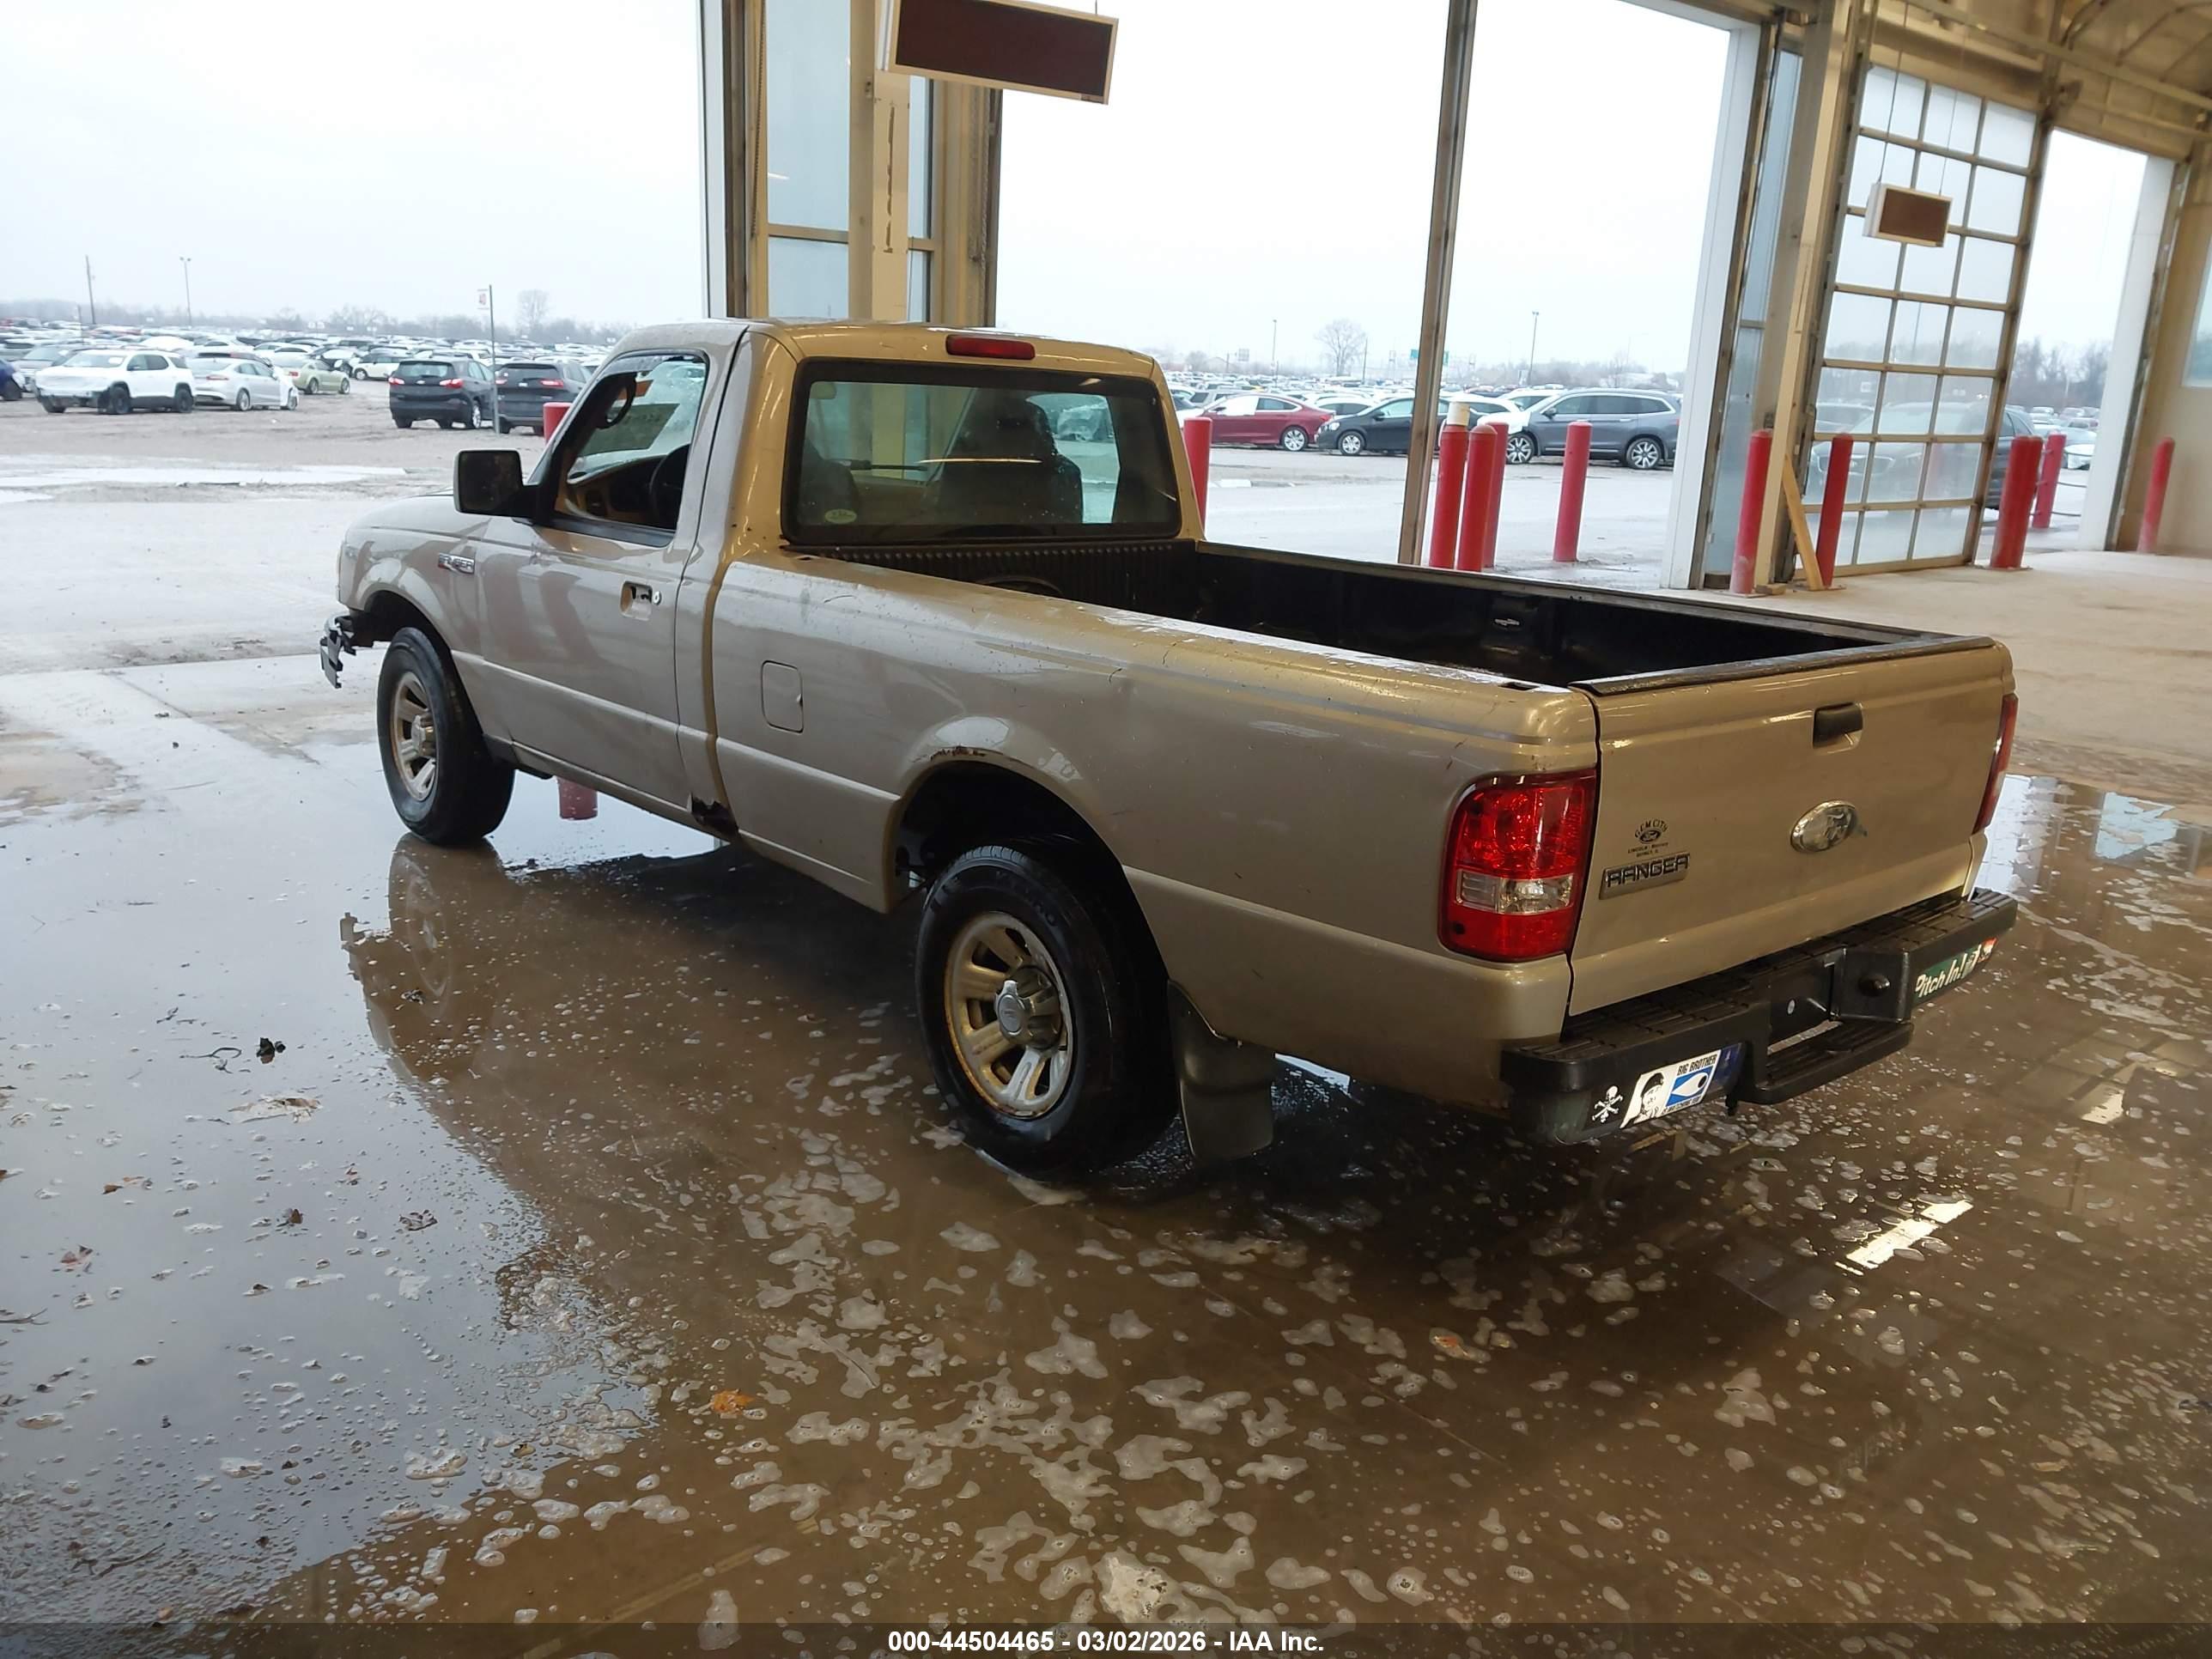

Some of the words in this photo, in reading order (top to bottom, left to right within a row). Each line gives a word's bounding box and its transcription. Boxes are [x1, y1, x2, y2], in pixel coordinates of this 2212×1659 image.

[1606, 853, 1691, 888] RANGER
[1915, 970, 1946, 998] Pitch
[1944, 953, 1968, 986] In!
[1677, 1063, 1689, 1076] BIG
[1689, 1054, 1717, 1072] BROTHER
